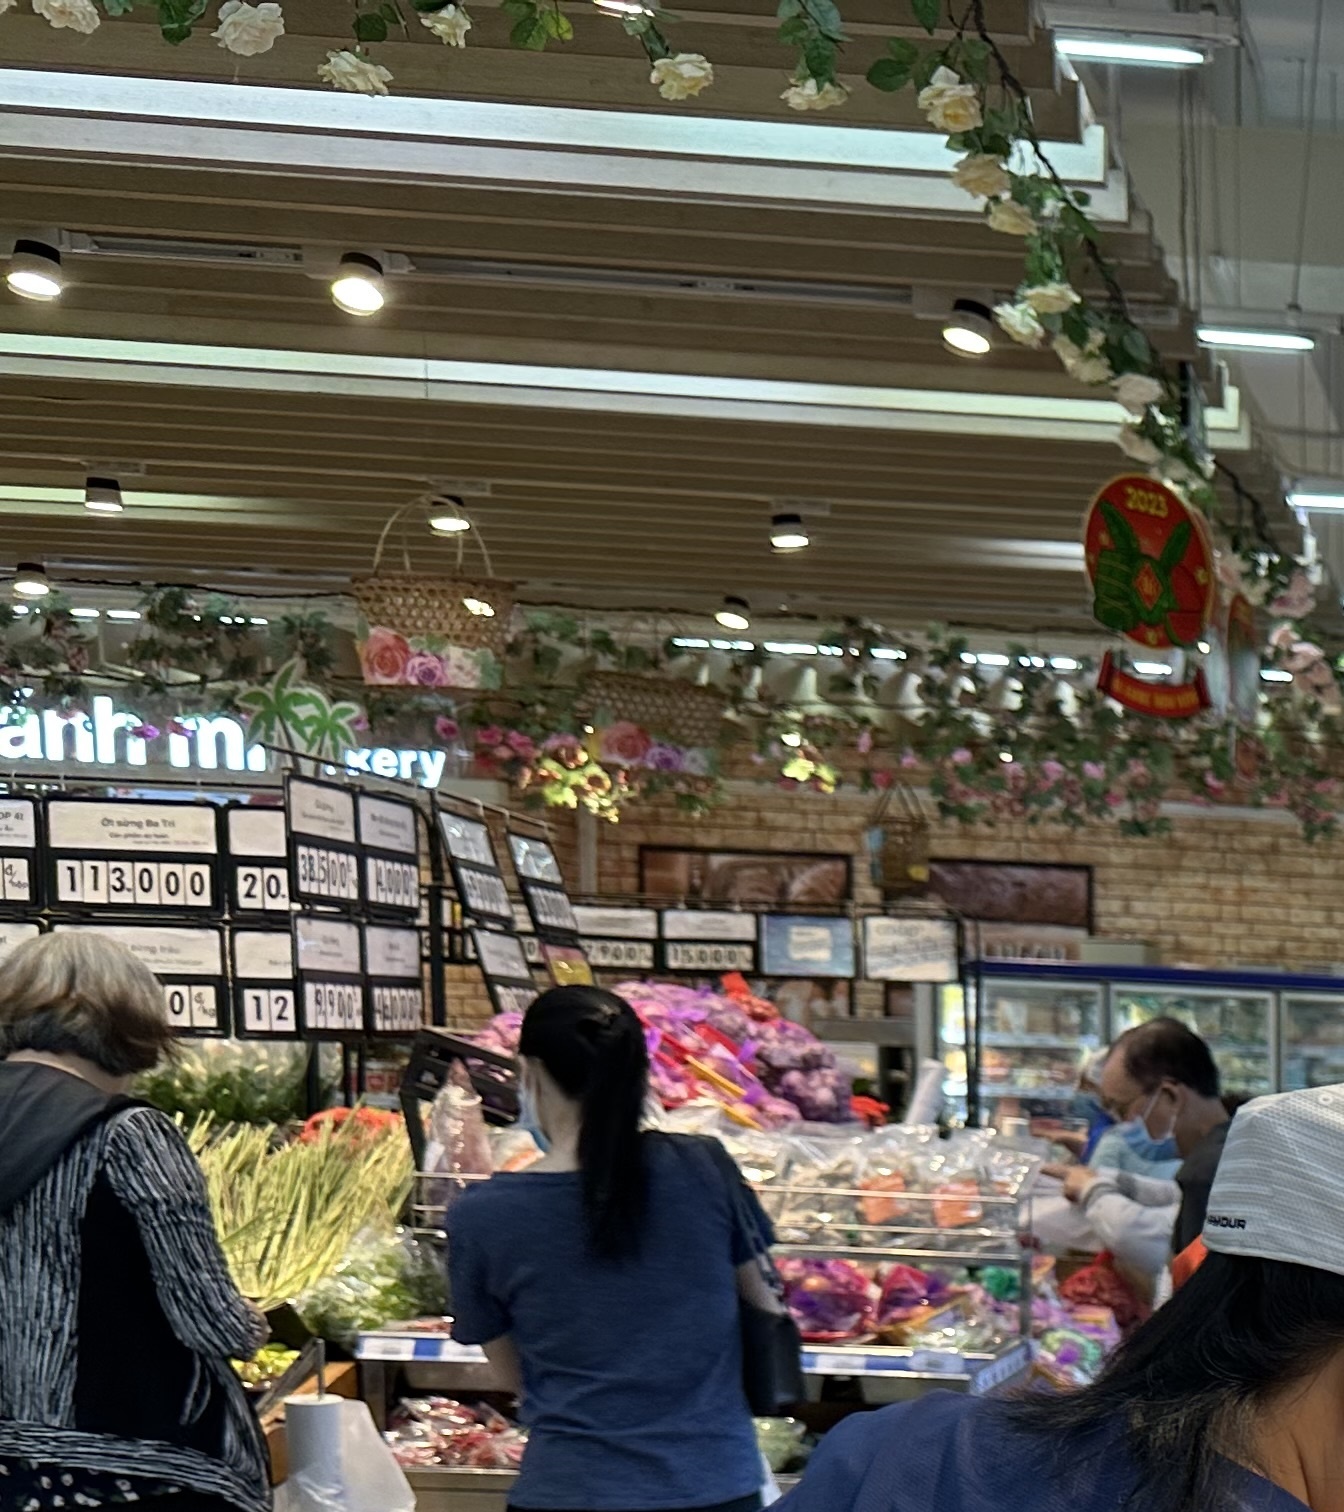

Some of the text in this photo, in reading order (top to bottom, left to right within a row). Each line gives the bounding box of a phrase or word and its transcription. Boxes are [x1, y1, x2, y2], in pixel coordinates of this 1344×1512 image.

[1124, 487, 1168, 518] 2023
[66, 865, 205, 897] 113.000
[300, 853, 348, 888] 38.500
[252, 995, 288, 1021] 12
